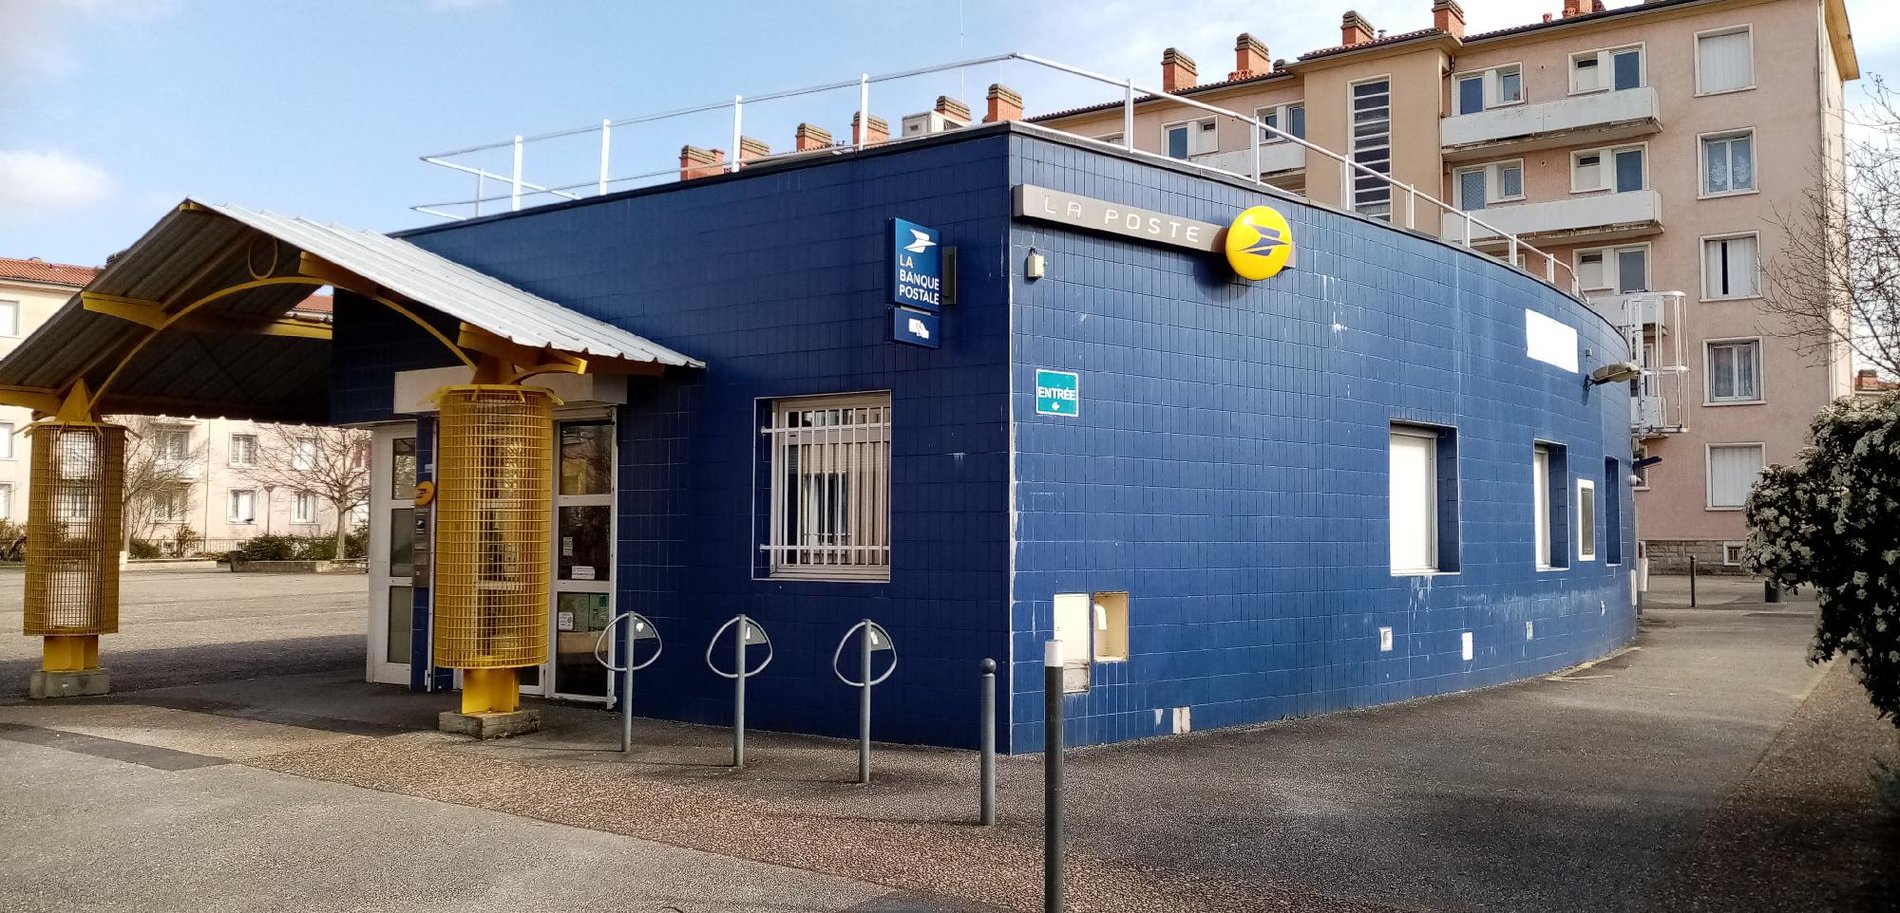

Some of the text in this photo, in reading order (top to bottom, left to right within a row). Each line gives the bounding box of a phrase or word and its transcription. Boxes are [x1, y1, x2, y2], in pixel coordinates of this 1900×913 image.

[1043, 194, 1201, 243] LA POSTE
[899, 254, 914, 269] LA
[899, 269, 940, 291] BANQUE
[899, 284, 940, 305] POSTALE
[1038, 386, 1076, 401] ENTRÉE
